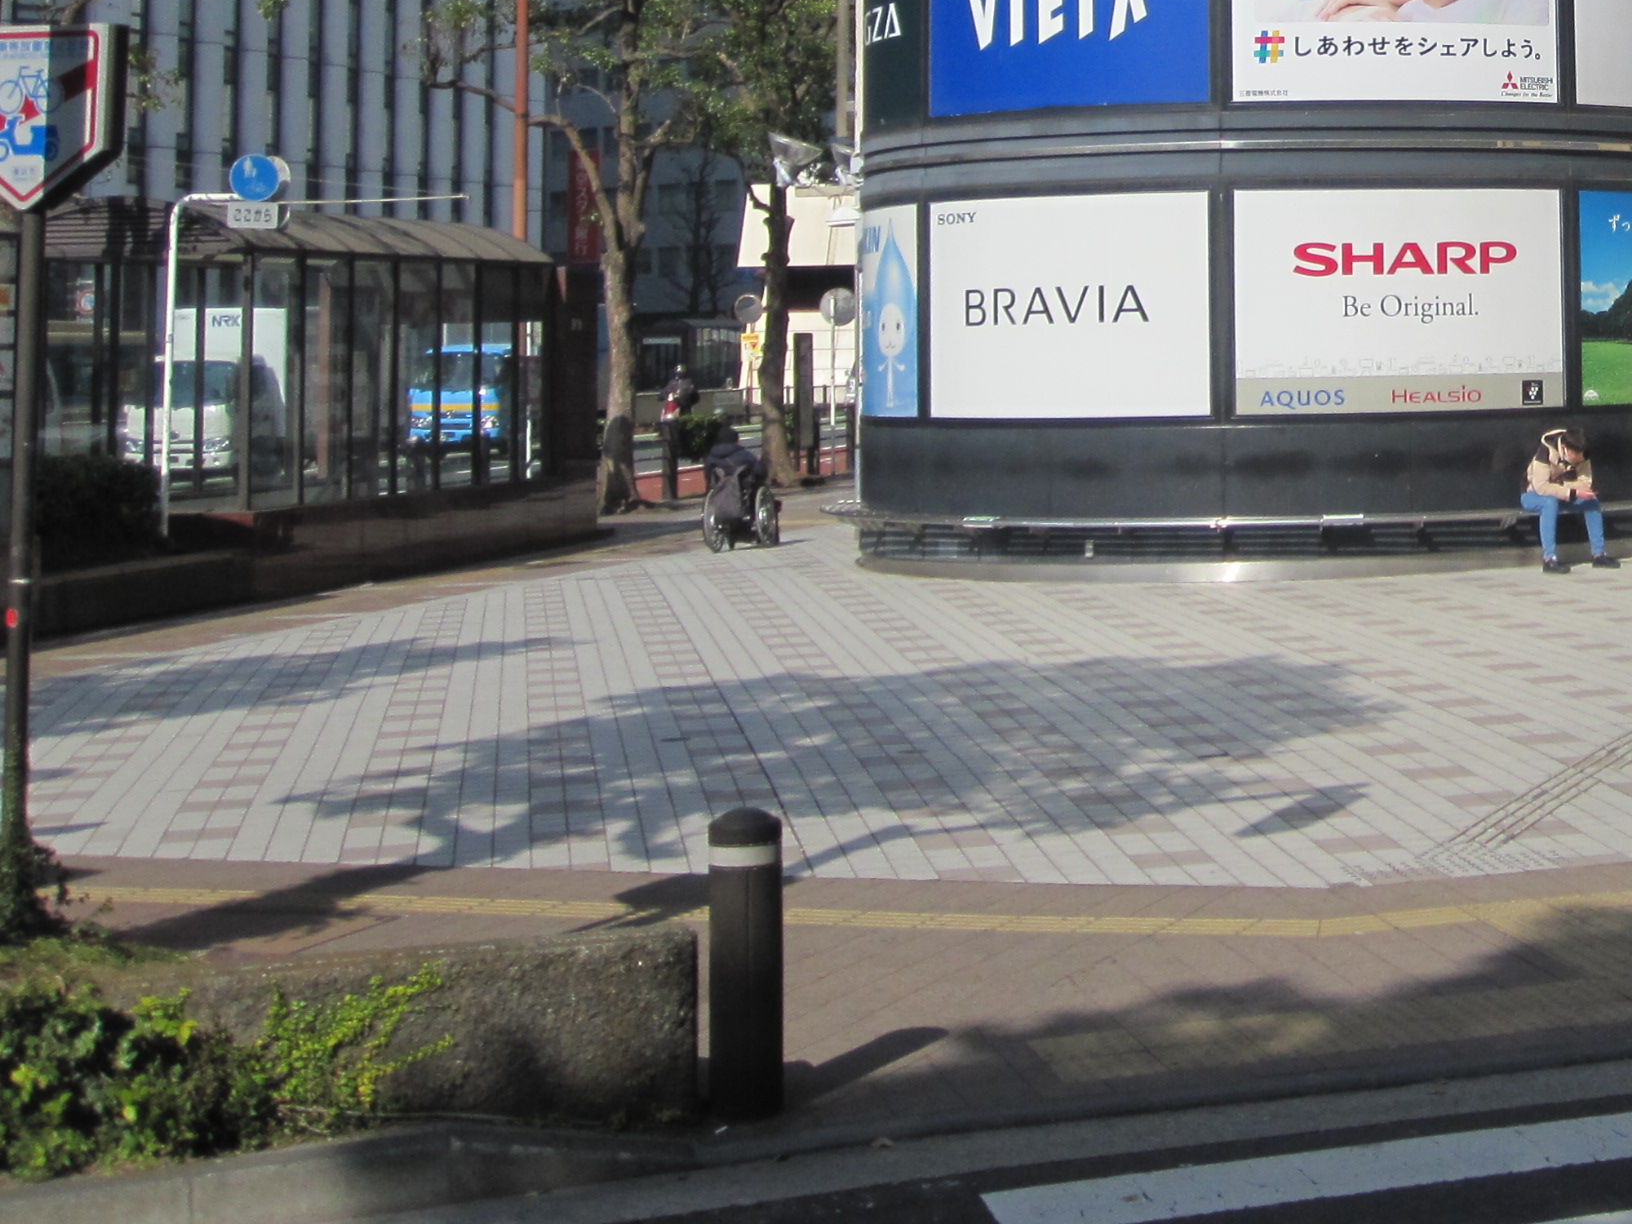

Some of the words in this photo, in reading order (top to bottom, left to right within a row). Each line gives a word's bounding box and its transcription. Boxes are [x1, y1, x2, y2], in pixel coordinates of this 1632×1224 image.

[937, 212, 977, 226] SONY
[1292, 241, 1518, 277] SHARP
[964, 284, 1150, 327] BRAVIA
[1342, 295, 1371, 318] Be
[1380, 293, 1479, 324] Original.
[1260, 389, 1346, 409] AQUOS
